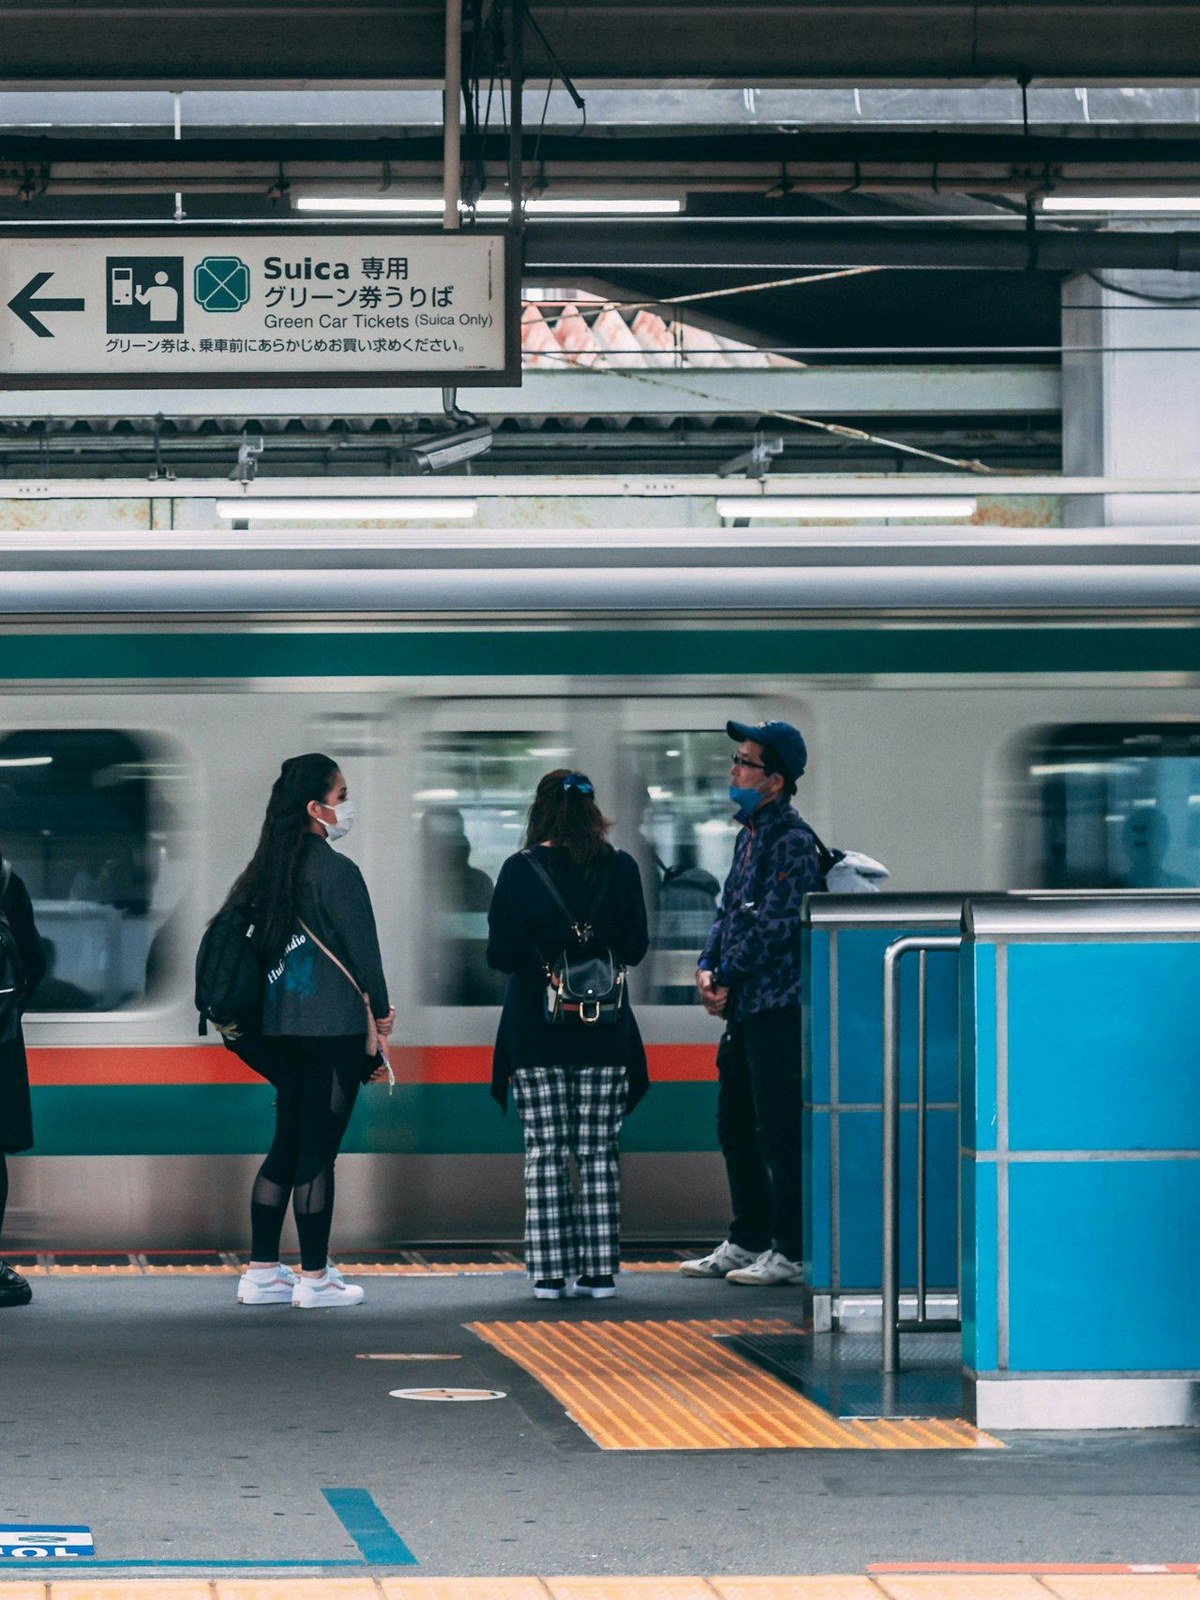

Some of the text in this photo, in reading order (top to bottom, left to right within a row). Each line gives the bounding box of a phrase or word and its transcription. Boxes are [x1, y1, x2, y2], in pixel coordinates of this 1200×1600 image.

[264, 256, 409, 281] Suica 専用
[264, 285, 454, 309] グリーン券うりば
[264, 313, 493, 328] Green Car Tickets (Suica Only)
[106, 338, 465, 353] グリーン券は、乗車前にあらかじめお買い求めください。
